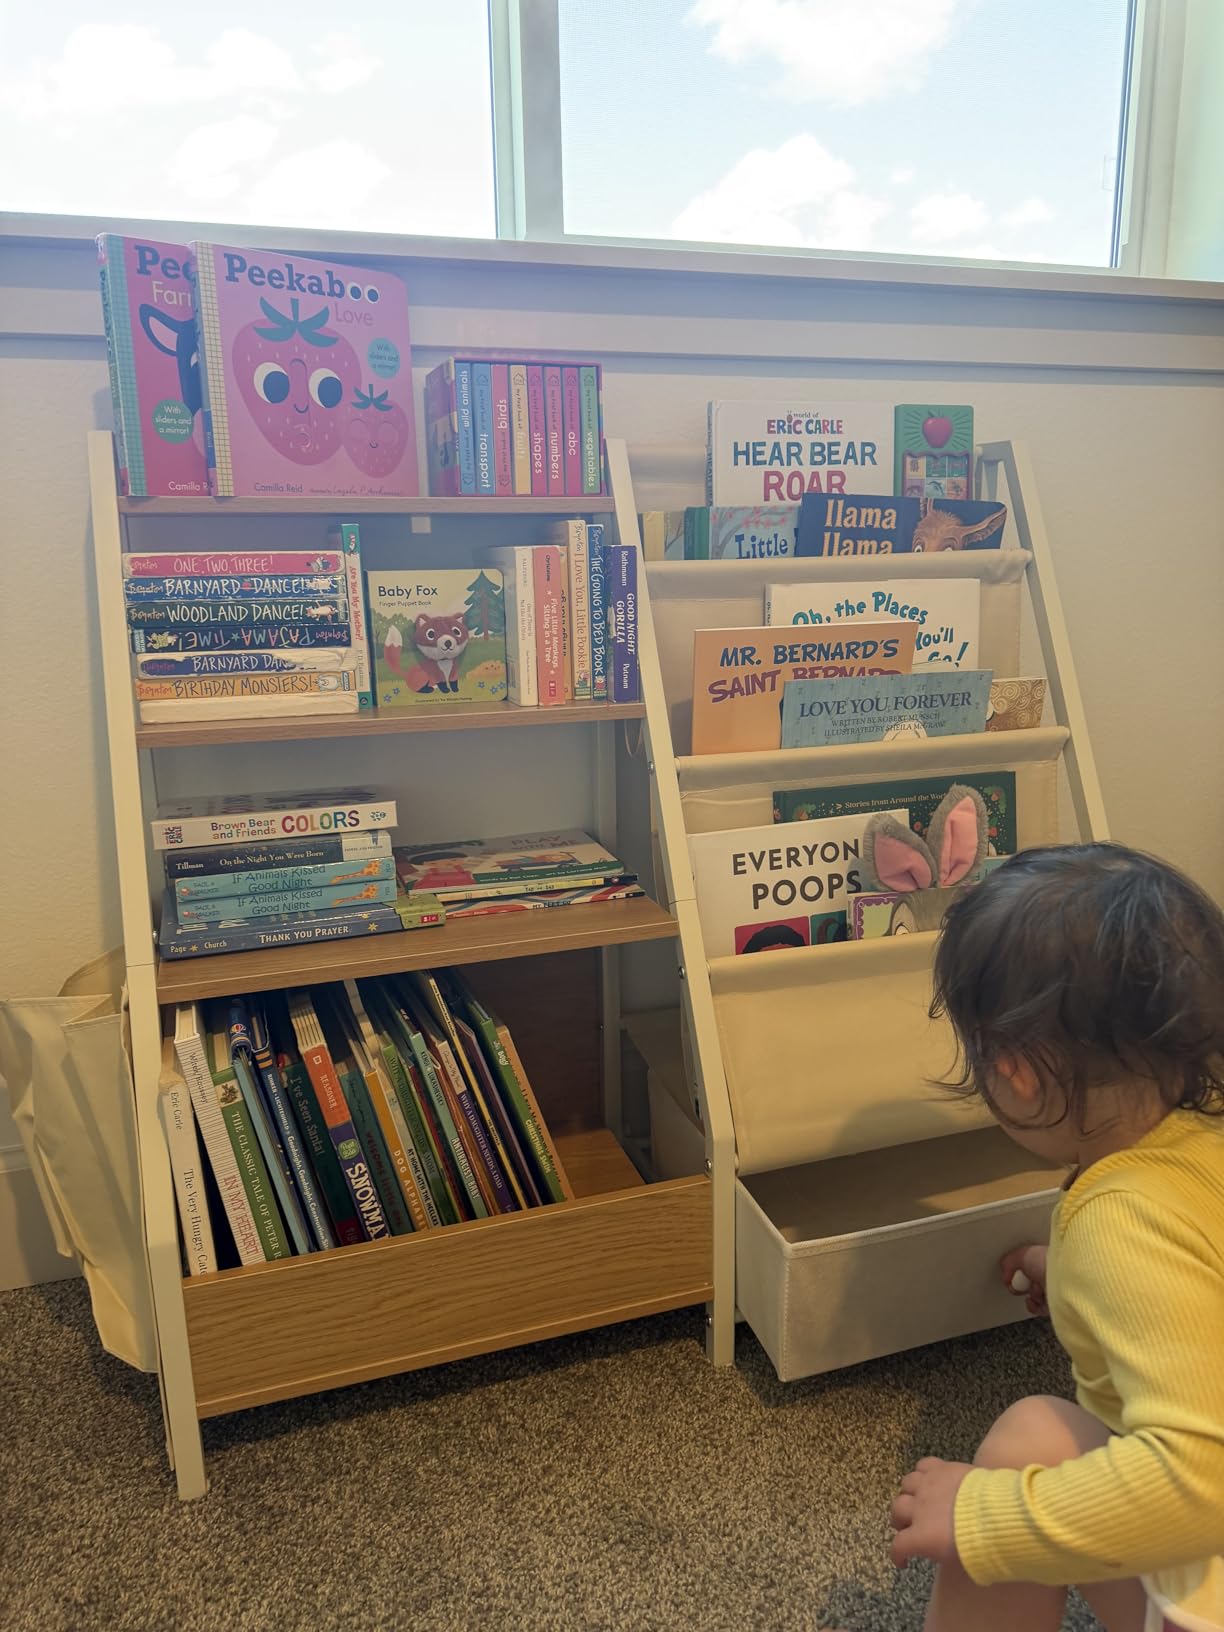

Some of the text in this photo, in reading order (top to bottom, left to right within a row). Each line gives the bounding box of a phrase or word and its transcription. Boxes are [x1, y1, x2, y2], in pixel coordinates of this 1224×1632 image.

[223, 253, 380, 304] Peekaboo
[334, 302, 375, 327] Love
[460, 370, 469, 405] animals
[155, 415, 192, 424] sliders and
[163, 405, 181, 415] With
[497, 399, 507, 429] birds
[805, 419, 844, 435] CARLE
[533, 432, 544, 474] shapes
[550, 432, 559, 480] numbers
[568, 432, 579, 456] abc
[733, 441, 877, 467] HEAR BEAR
[480, 433, 491, 488] transport
[586, 432, 597, 487] vegetables
[168, 481, 200, 491] Camilla
[254, 481, 284, 492] Camilla
[286, 482, 303, 493] Reid
[762, 470, 847, 501] ROAR
[734, 533, 789, 560] Little
[232, 554, 274, 573] THREE!
[349, 566, 357, 579] Are
[575, 559, 584, 582] Love
[621, 551, 629, 586] Rathmann
[163, 577, 240, 596] BARNYARD
[251, 576, 305, 595] DANCE!
[350, 581, 359, 594] You
[377, 584, 438, 600] Baby Fox
[574, 585, 585, 607] You,
[130, 603, 304, 624] Boynton WOODLAND DANCE!
[351, 596, 360, 609] My
[378, 600, 401, 608] Finger
[402, 600, 418, 608] Puppet
[591, 555, 605, 675] THE GOING TO BED BOOK
[792, 609, 831, 625] Oh,
[834, 599, 866, 618] the
[872, 591, 928, 625] Places
[543, 604, 551, 628] Sitting
[551, 616, 559, 634] Little
[576, 609, 586, 634] Little
[616, 601, 625, 643] GORILLA
[241, 626, 315, 649] PAJAMA
[192, 654, 258, 671] BARNYARD
[551, 636, 560, 668] Monkeys
[577, 636, 587, 668] Pookie
[719, 639, 899, 667] MR. BERNARD'S
[172, 678, 237, 699] BIRTHDAY
[240, 676, 314, 695] MONSTERS!
[708, 669, 781, 703] SAINT
[800, 691, 973, 718] LOVE YOU FOREVER
[824, 726, 873, 737] ILLUSTRATED
[874, 725, 884, 733] BY
[885, 722, 912, 732] SHEILA
[831, 717, 866, 727] WRITTEN
[866, 717, 876, 725] BY
[877, 714, 906, 724] ROBERT
[845, 794, 929, 809] Stories from Around the
[211, 819, 275, 832] Brown Bear
[212, 826, 277, 840] and Friends
[281, 810, 360, 834] COLORS
[175, 849, 324, 871] Tillman On the Night You Were Born
[732, 839, 859, 875] EVERYON
[232, 865, 326, 884] If Animals Kissed
[248, 877, 313, 893] Good Night
[237, 888, 323, 908] If Animals Kissed
[752, 870, 862, 910] POOPS
[251, 901, 311, 916] Good Night
[170, 925, 349, 954] Page Church THANK YOU PRAYER
[320, 1074, 338, 1109] REASONER
[290, 1076, 325, 1155] I've Seen Santa!
[389, 1057, 401, 1076] WHY
[413, 1125, 427, 1149] NEEDS
[424, 1154, 436, 1173] MOM
[460, 1094, 472, 1110] WHY
[469, 1115, 486, 1147] DAUGHTER
[482, 1146, 495, 1170] NEEDS
[493, 1175, 502, 1189] DAD
[525, 1118, 551, 1174] CHRISTMAS SWIM
[170, 1092, 202, 1256] Eric Carle The Very Hungry
[394, 1150, 407, 1174] DOG
[451, 1137, 473, 1179] ANTIRACIST
[467, 1180, 481, 1199] BABY
[230, 1112, 279, 1251] THE CLASSIC TALE OF PETER
[287, 1135, 303, 1170] Goodnight,
[298, 1170, 313, 1203] Goodnight,
[309, 1203, 326, 1240] Construction
[407, 1148, 439, 1226] AT HOME WITH THE HEELERS
[223, 1175, 259, 1255] IN MY HEART
